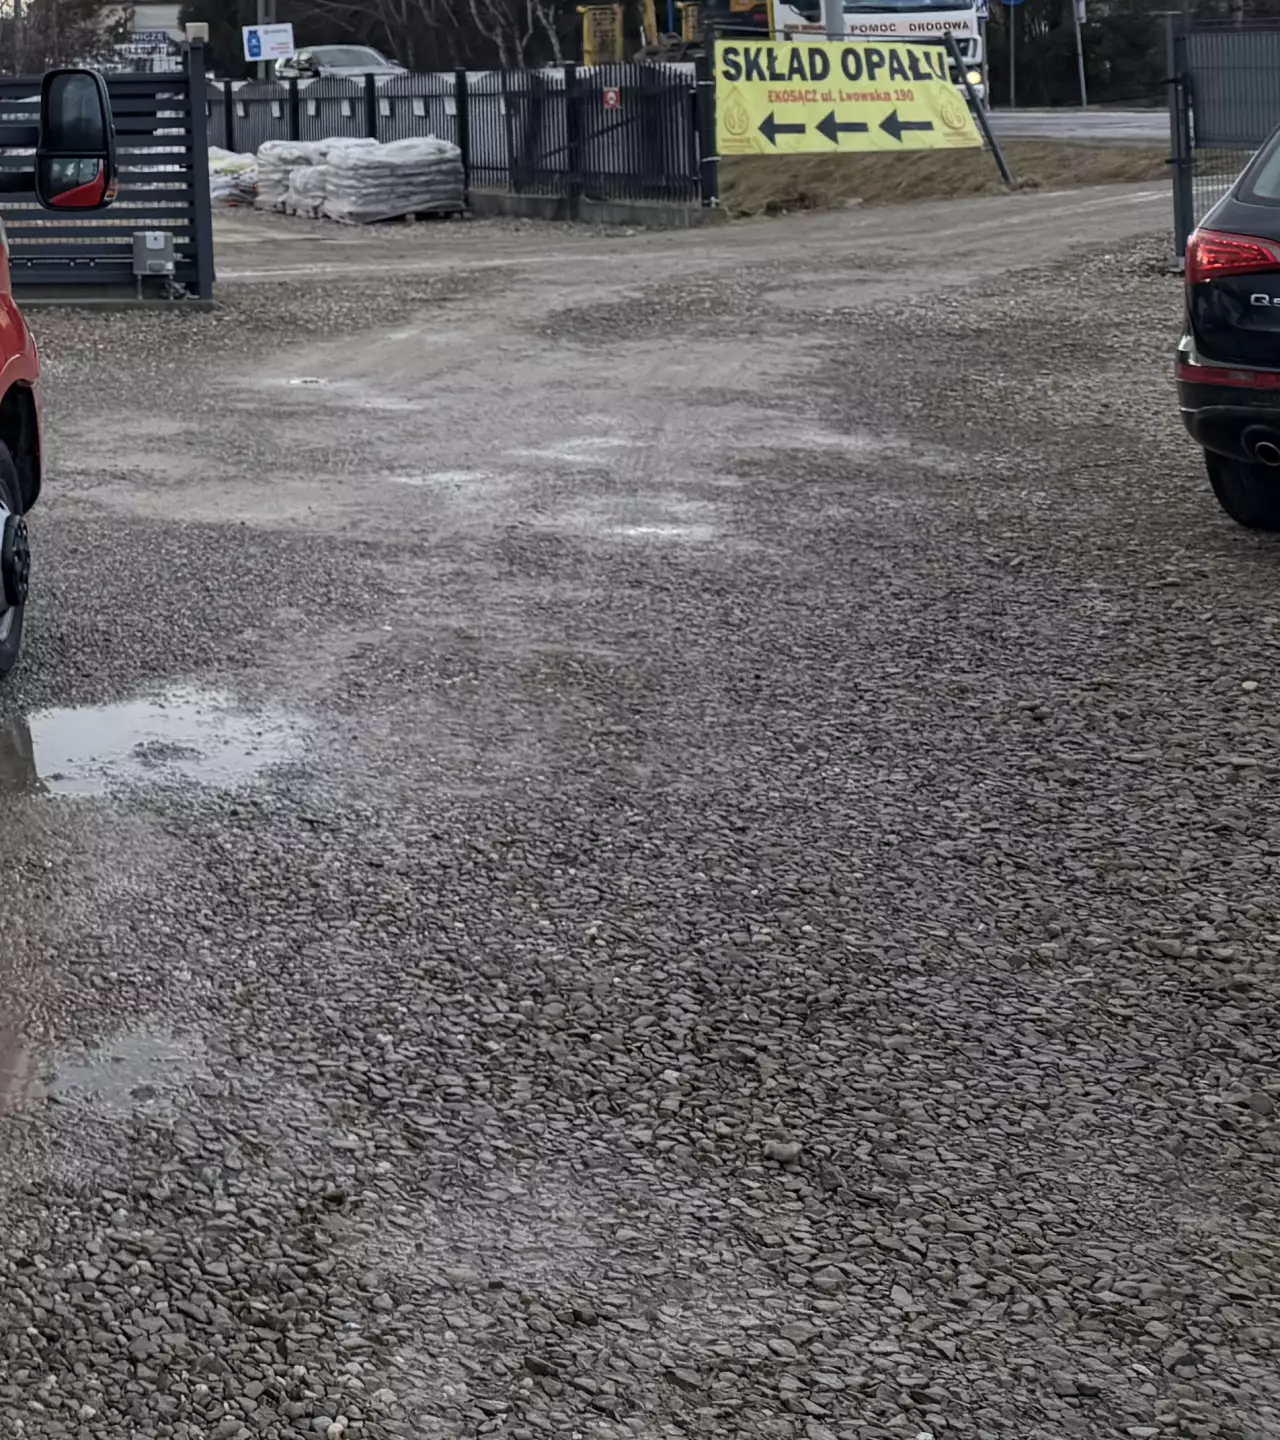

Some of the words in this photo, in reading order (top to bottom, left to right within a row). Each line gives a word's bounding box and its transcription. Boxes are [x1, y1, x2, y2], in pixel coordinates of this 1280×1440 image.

[850, 23, 897, 33] POMOC
[909, 21, 970, 32] DROGOWA
[721, 47, 831, 82] SKŁAD
[840, 47, 948, 82] OPAŁU
[821, 89, 836, 102] ul.
[839, 88, 892, 102] Lwowska
